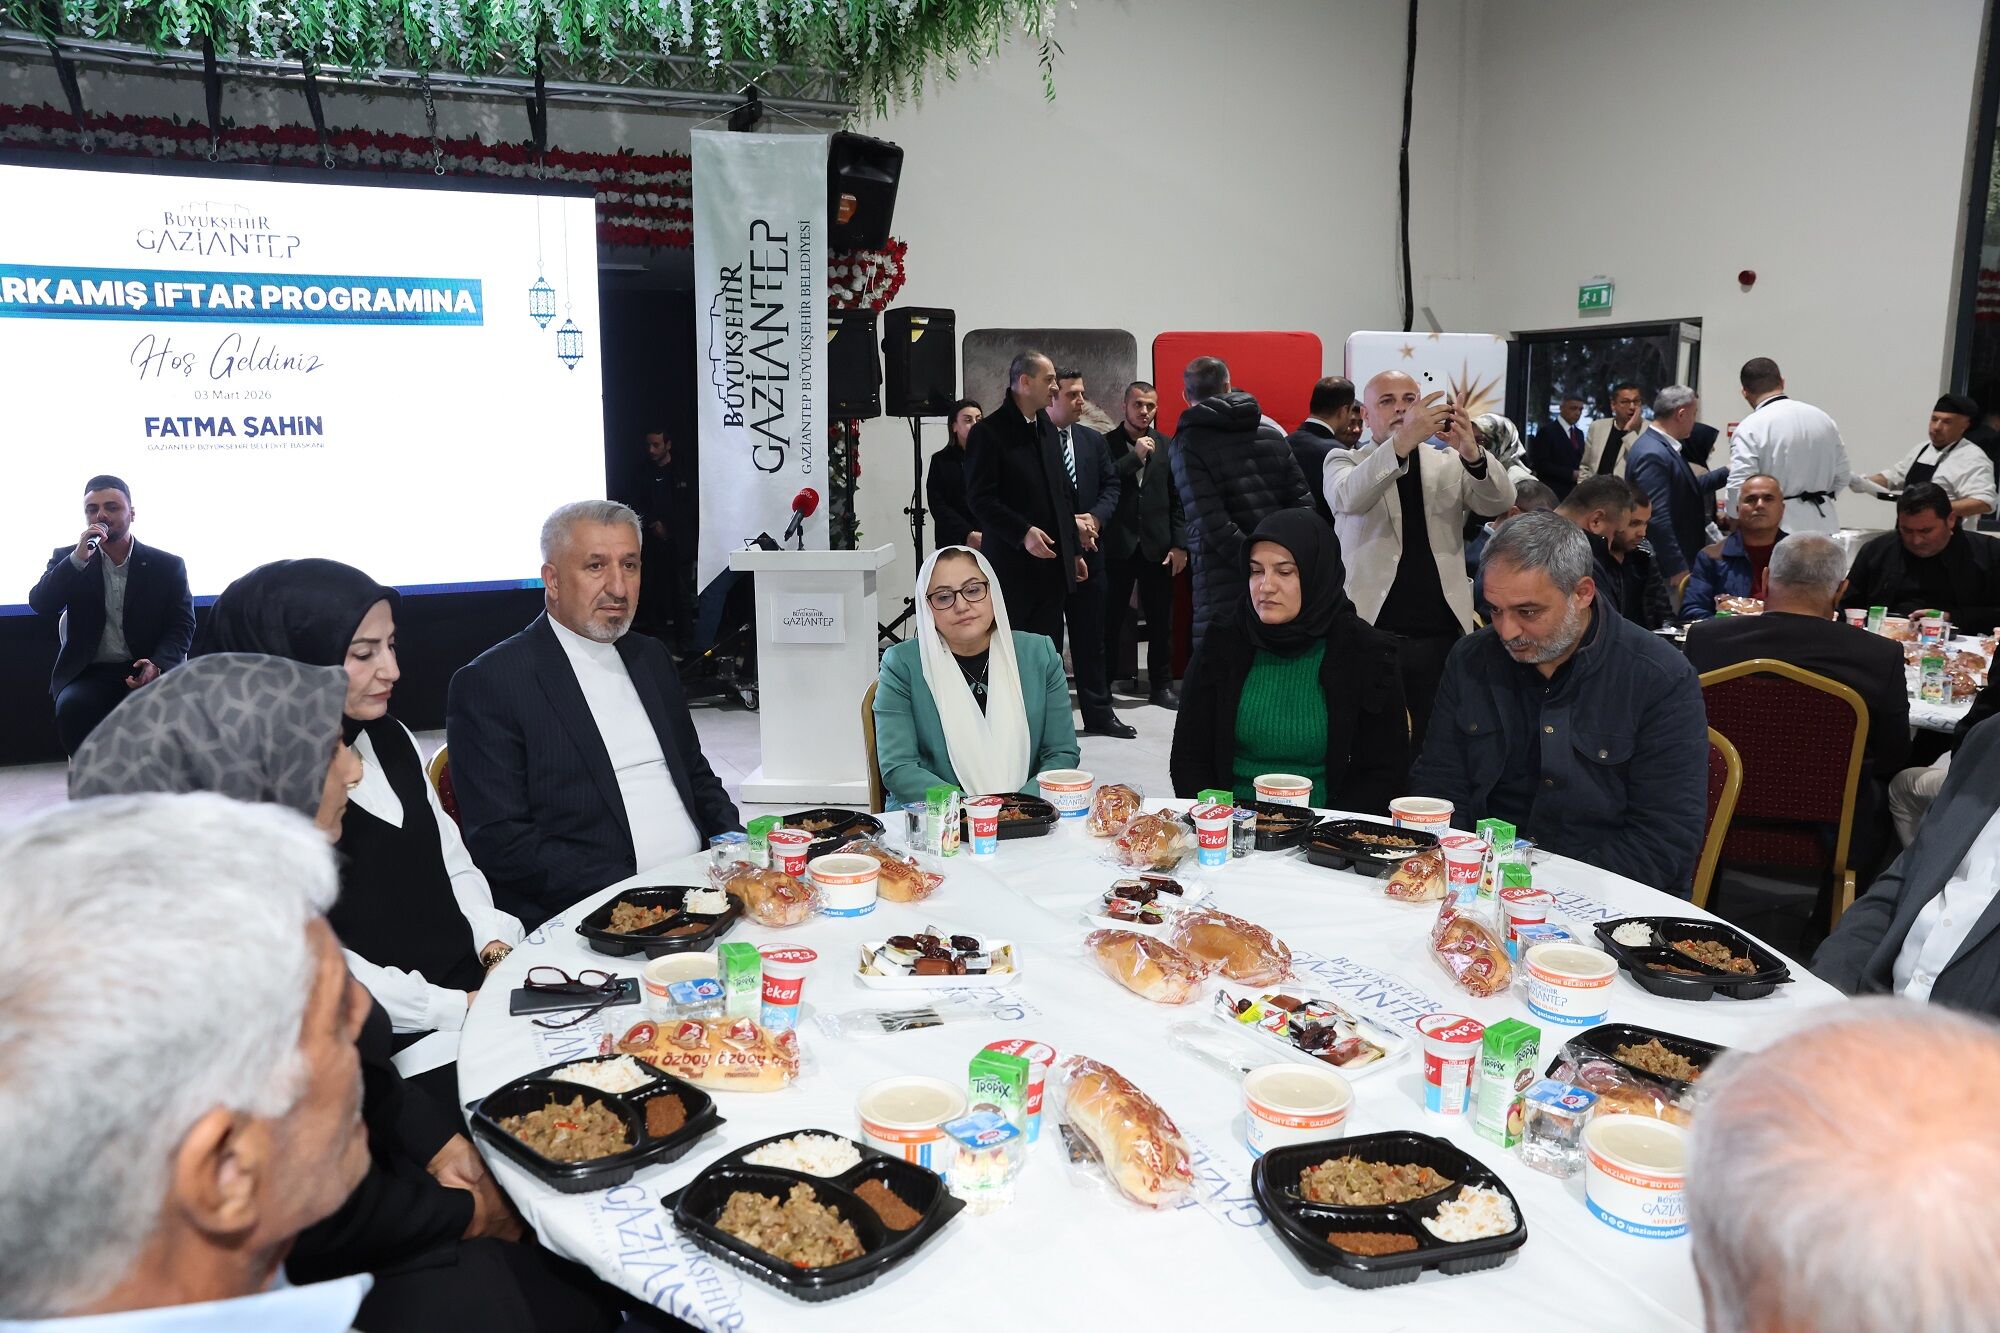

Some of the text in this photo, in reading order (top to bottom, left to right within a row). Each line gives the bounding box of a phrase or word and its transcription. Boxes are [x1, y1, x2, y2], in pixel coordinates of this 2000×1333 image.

[0, 276, 477, 314] RKAMIŞ İFTAR PROGRAMINA
[130, 332, 325, 381] Hoş Geldiniz
[746, 219, 790, 473] GAZİANTEP
[798, 220, 815, 474] GAZİANTEP BÜYÜKŞEHİR BELEDİYESİ
[194, 390, 272, 400] 03 Mart 2026
[144, 416, 237, 438] FATMA
[972, 1079, 1011, 1099] Tropix
